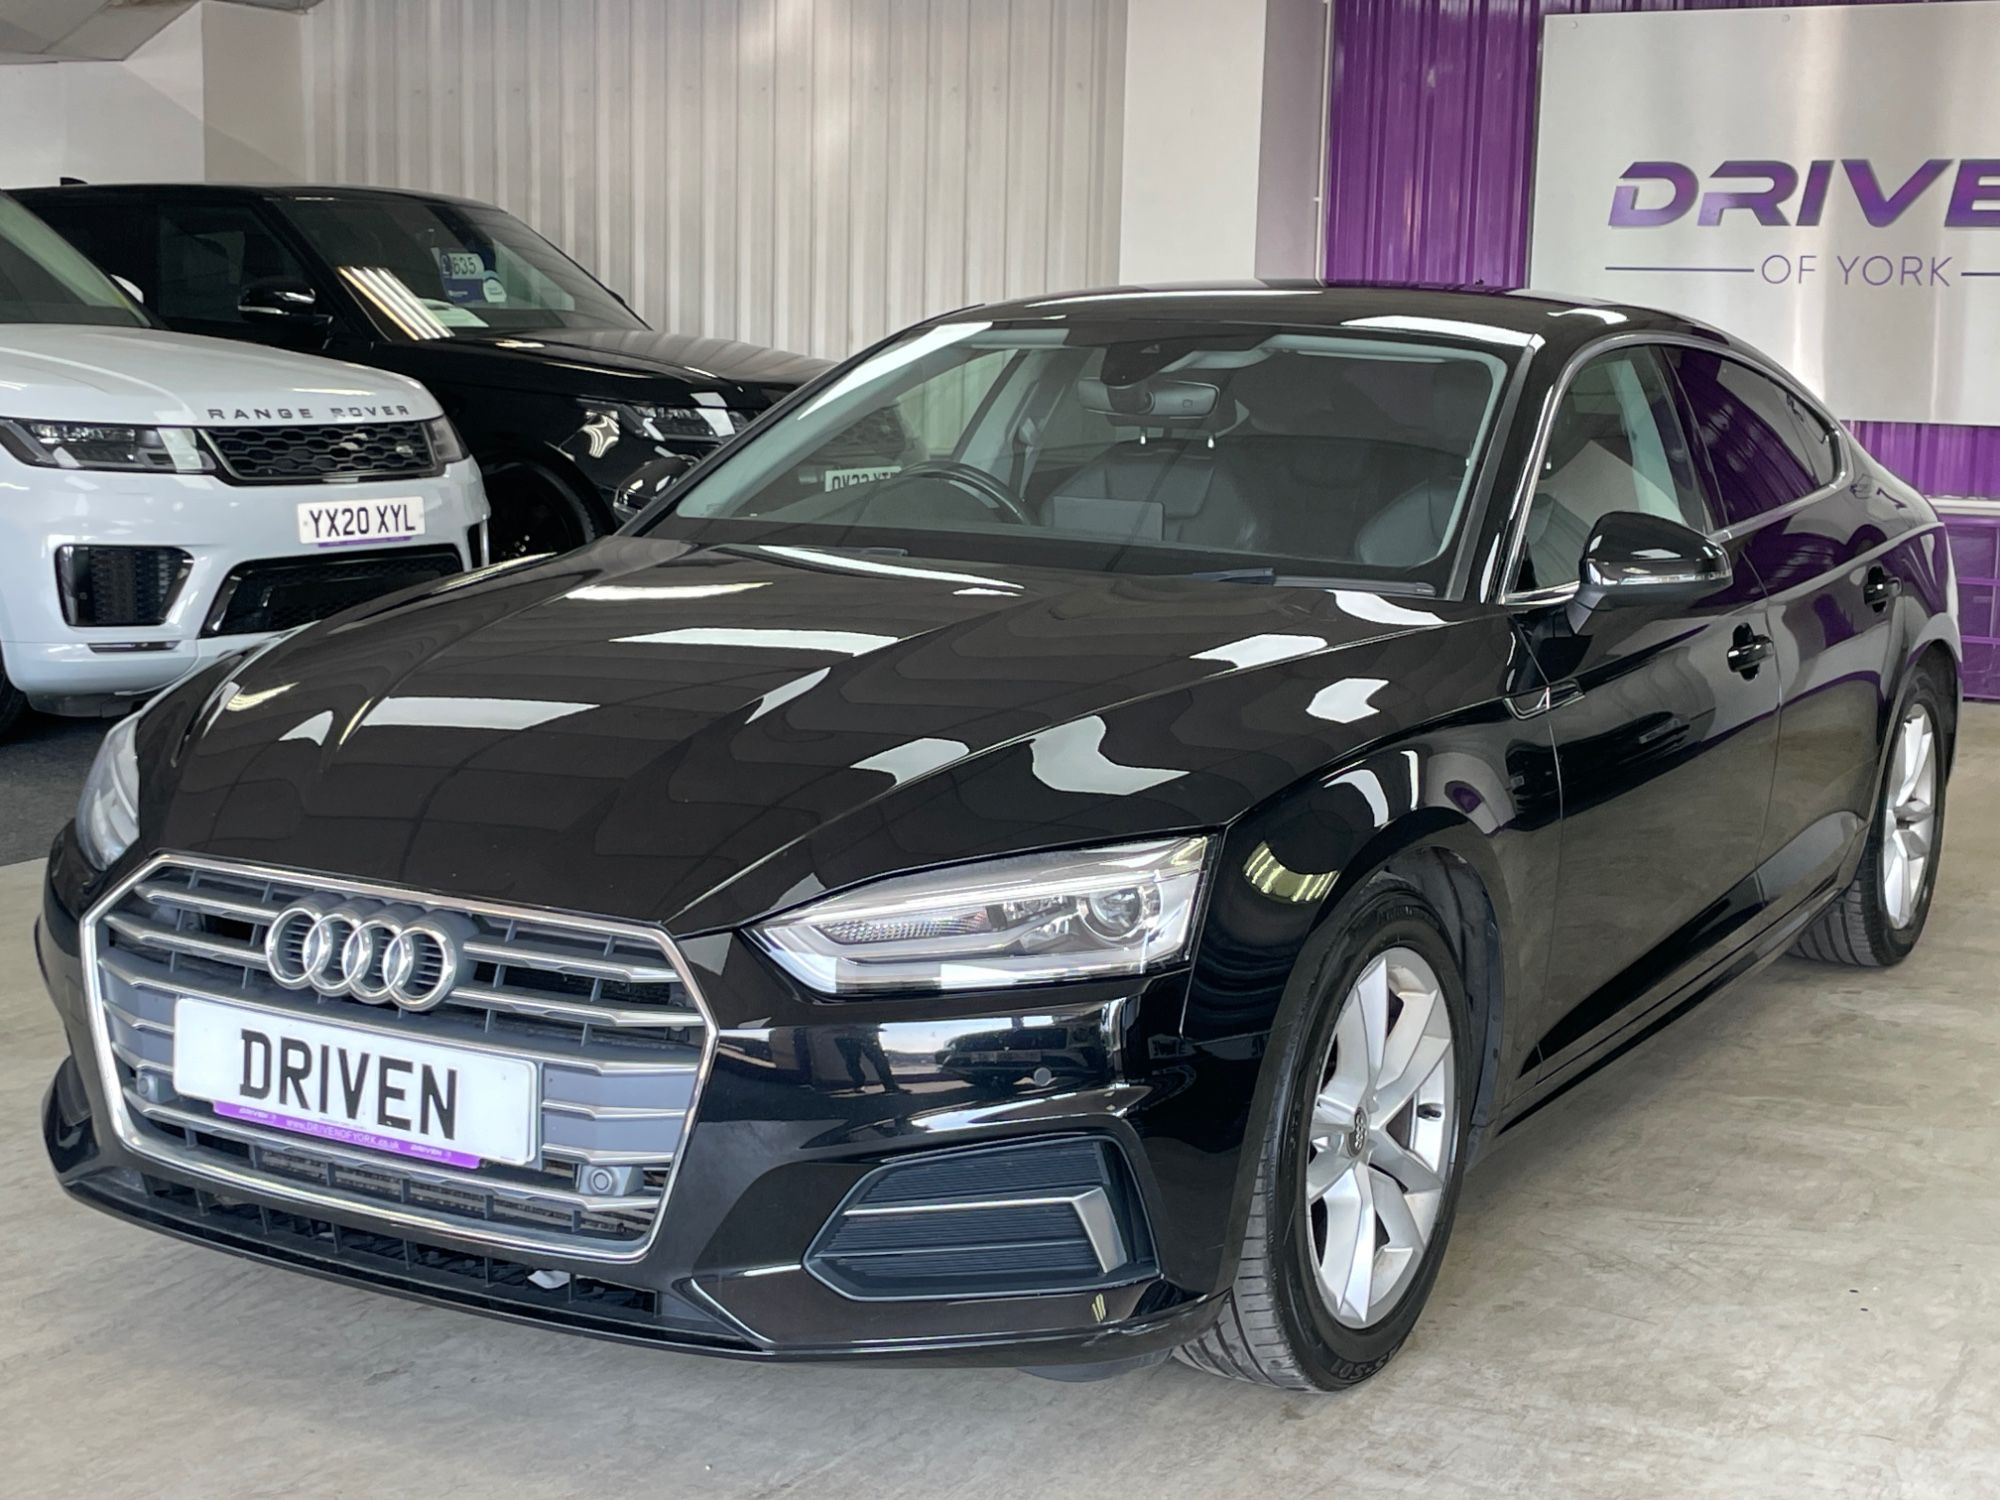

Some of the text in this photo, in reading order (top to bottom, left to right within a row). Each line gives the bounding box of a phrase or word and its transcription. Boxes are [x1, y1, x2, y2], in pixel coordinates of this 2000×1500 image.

[1761, 254, 1953, 287] OF YORK
[207, 404, 411, 420] RANGE ROVER
[308, 504, 416, 539] YX20 XYL
[239, 1028, 457, 1140] DRIVEN
